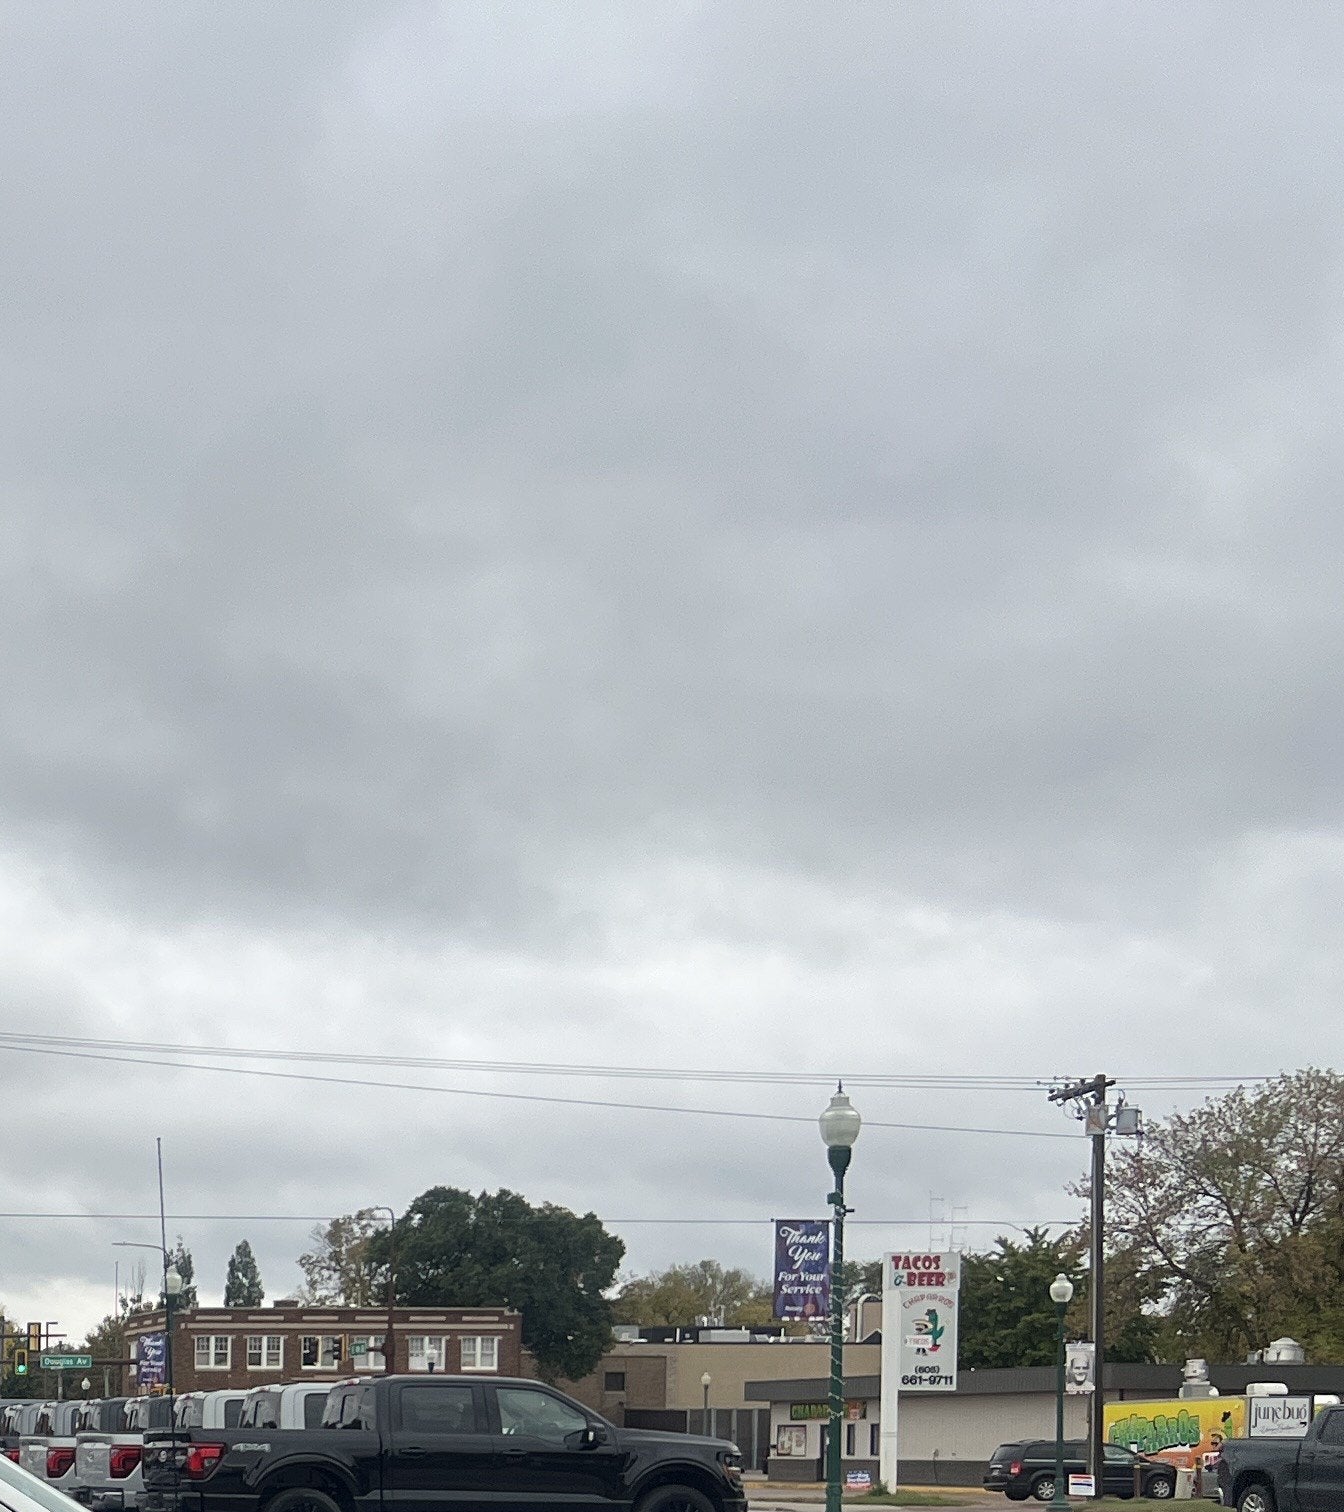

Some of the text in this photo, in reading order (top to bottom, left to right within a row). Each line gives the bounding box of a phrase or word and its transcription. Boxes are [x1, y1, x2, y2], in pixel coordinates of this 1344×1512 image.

[779, 1226, 825, 1246] Thank
[788, 1245, 822, 1269] You
[892, 1255, 941, 1270] TACOS
[778, 1271, 825, 1281] For Your
[907, 1272, 946, 1287] BEER
[780, 1284, 823, 1294] Service
[44, 1357, 87, 1366] Douglas Av
[901, 1375, 954, 1386] 661-9711
